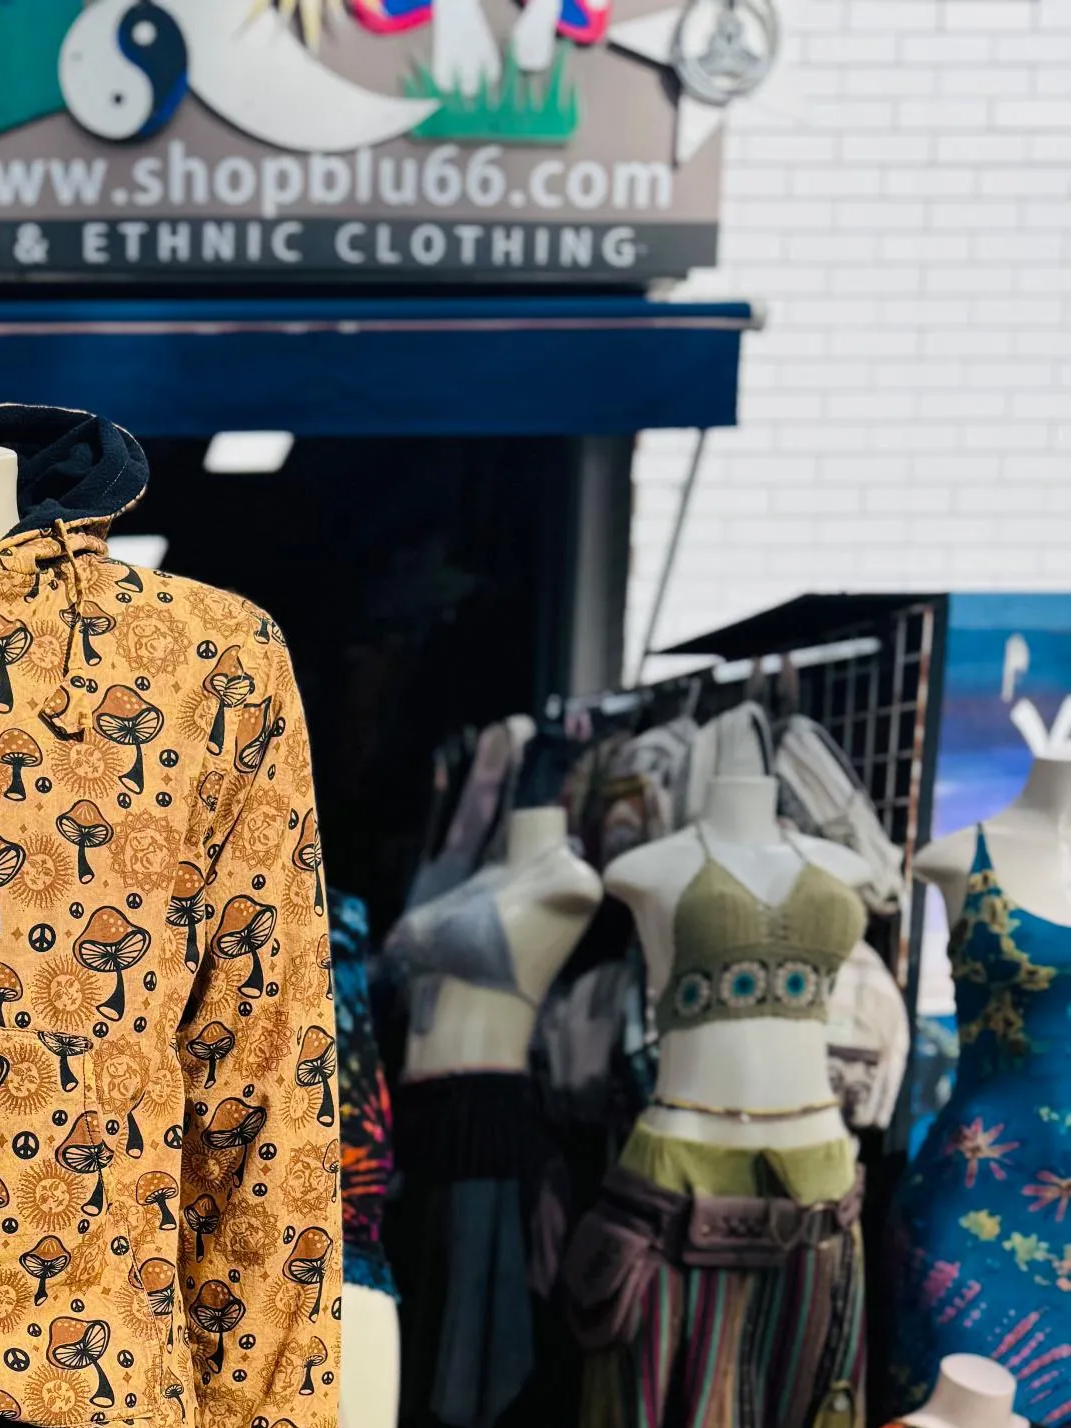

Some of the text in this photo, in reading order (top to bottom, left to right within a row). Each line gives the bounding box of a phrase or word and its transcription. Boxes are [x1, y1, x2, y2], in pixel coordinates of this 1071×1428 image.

[14, 222, 48, 264] &
[83, 220, 302, 264] ETHNIC
[335, 221, 638, 269] CLOTHING
